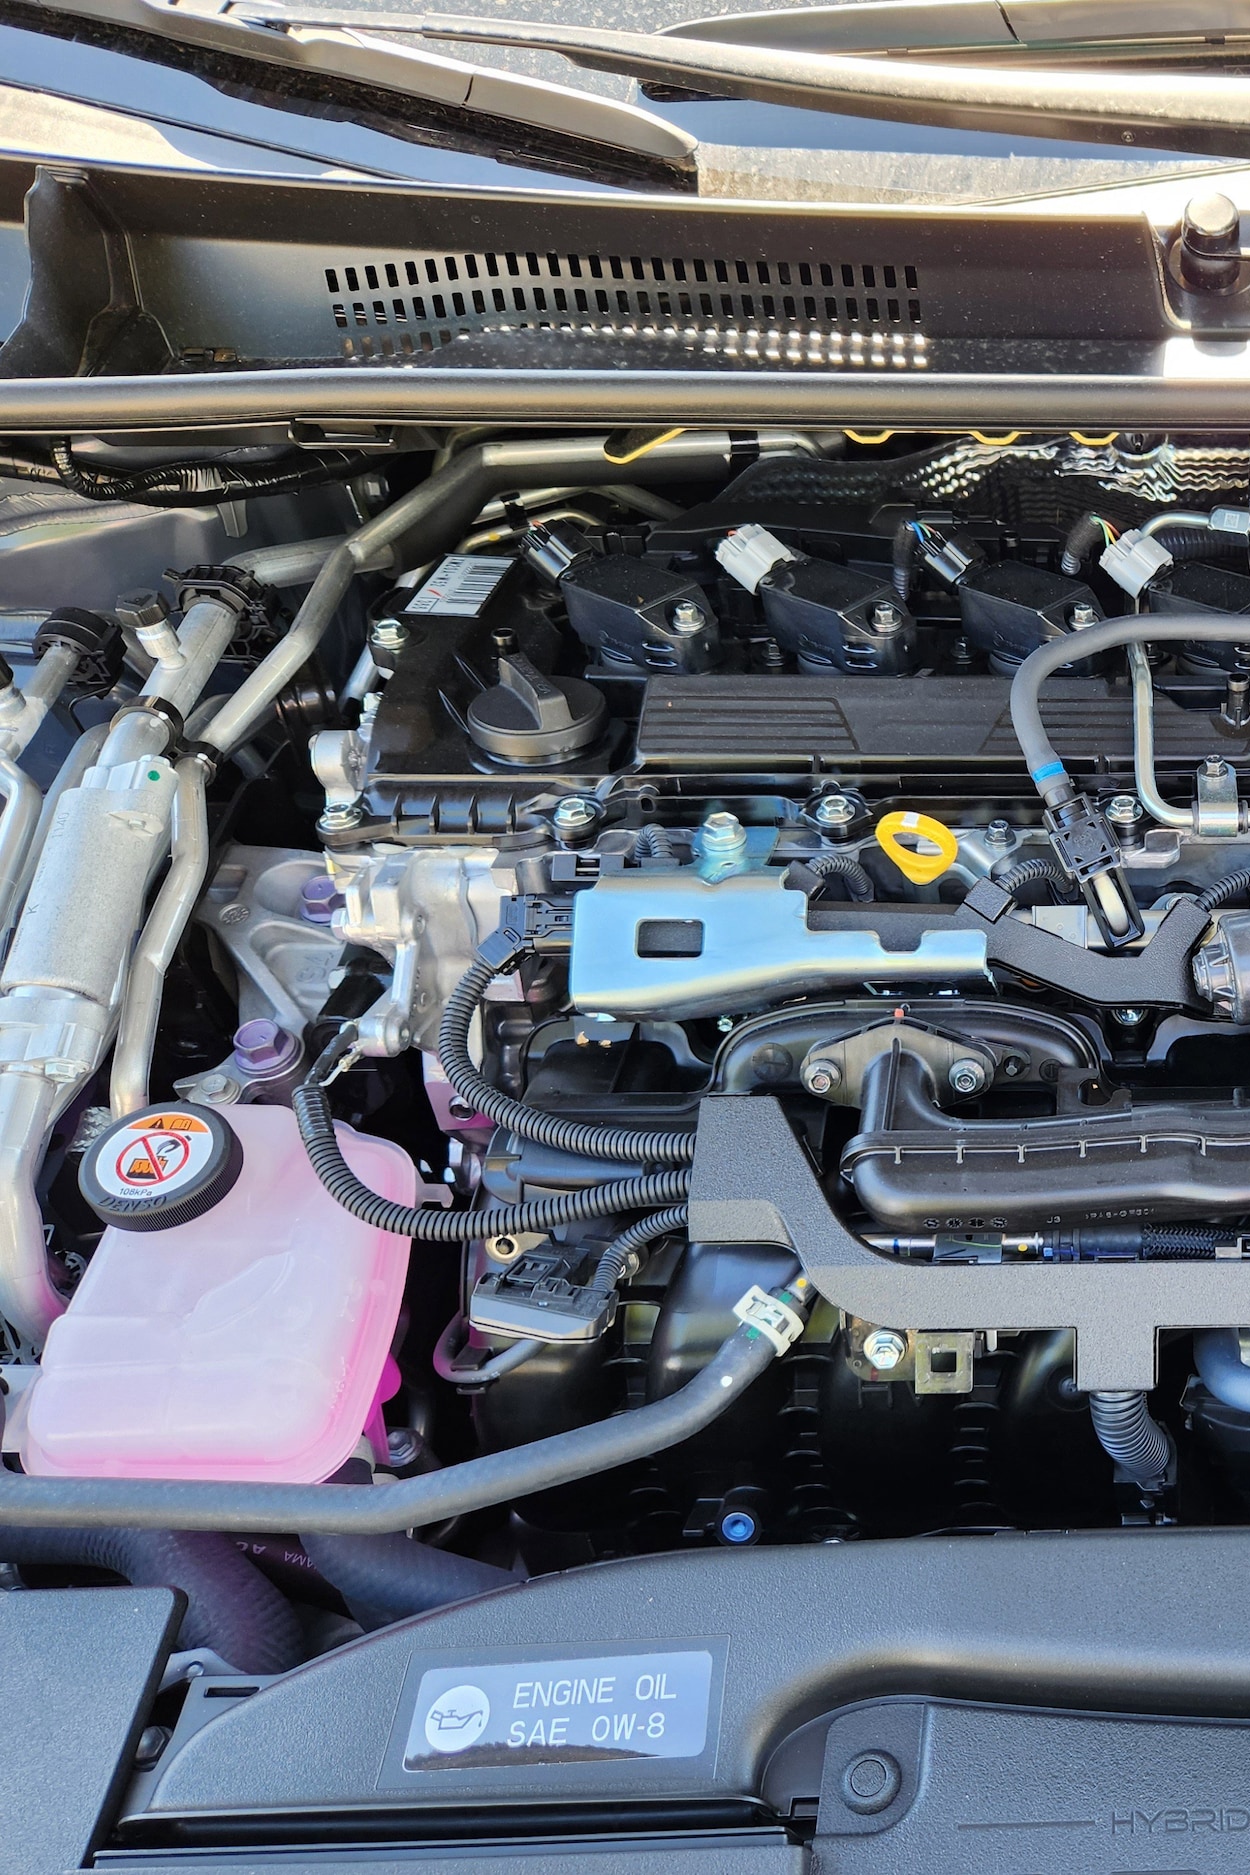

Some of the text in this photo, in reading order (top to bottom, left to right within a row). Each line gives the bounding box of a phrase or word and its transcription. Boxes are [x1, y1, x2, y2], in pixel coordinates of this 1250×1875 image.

[98, 1196, 167, 1212] DENSO
[120, 1188, 152, 1196] 108kPa
[513, 1674, 677, 1708] ENGINE OIL
[507, 1712, 665, 1747] SAE 0W-8
[1110, 1807, 1250, 1836] HYBRID
